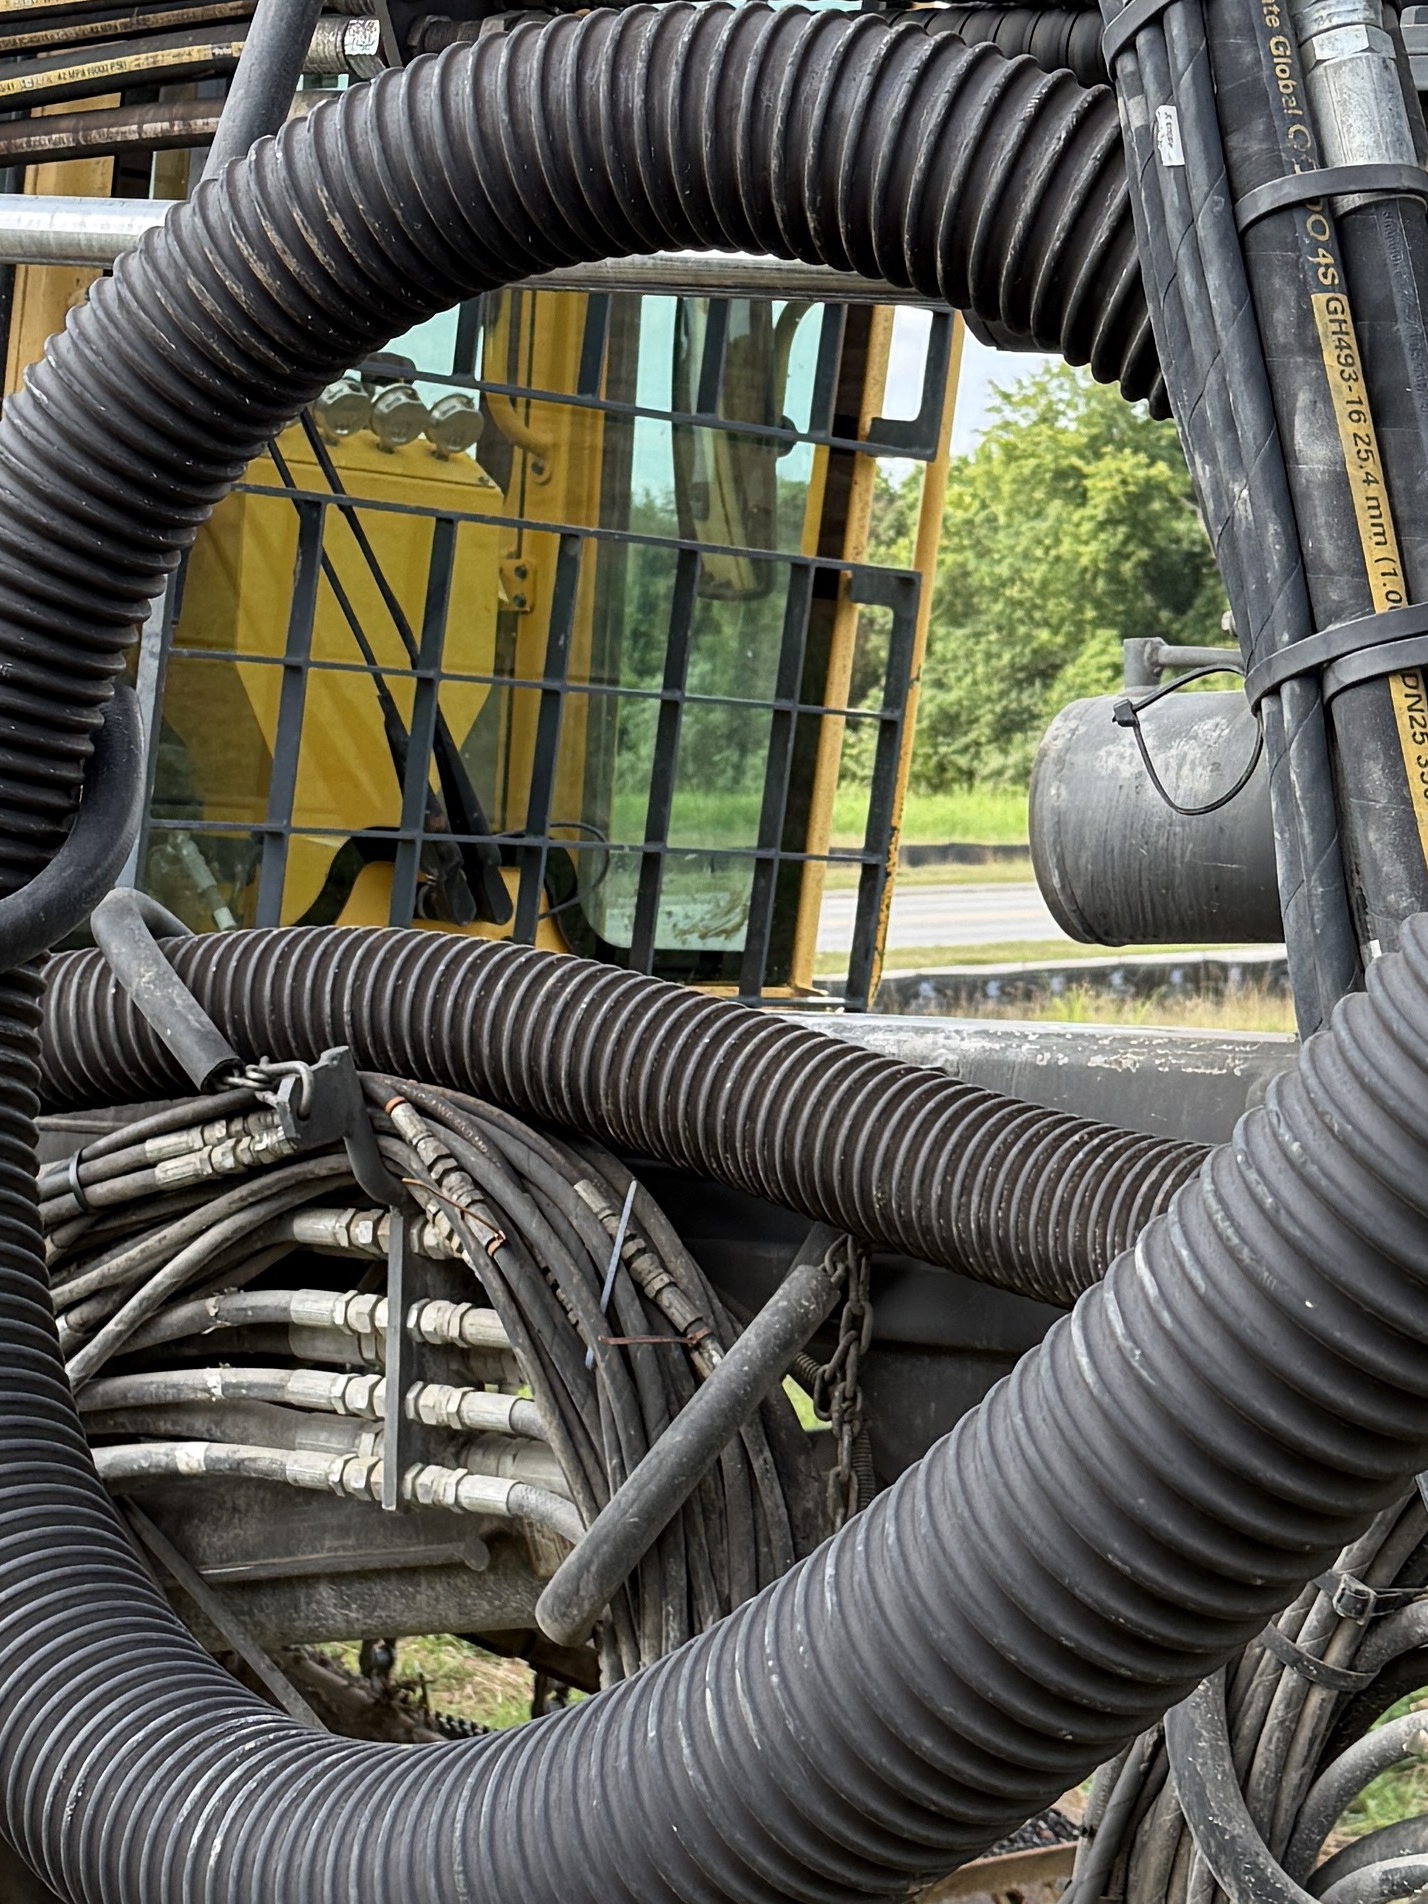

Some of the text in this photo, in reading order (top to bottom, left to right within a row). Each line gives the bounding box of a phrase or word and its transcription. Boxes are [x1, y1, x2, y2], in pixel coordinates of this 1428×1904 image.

[1267, 35, 1304, 117] Global
[1325, 297, 1368, 425] GH493-16
[1352, 432, 1380, 486] 25.4
[1365, 497, 1388, 549] mm
[1372, 556, 1406, 610] (1.0
